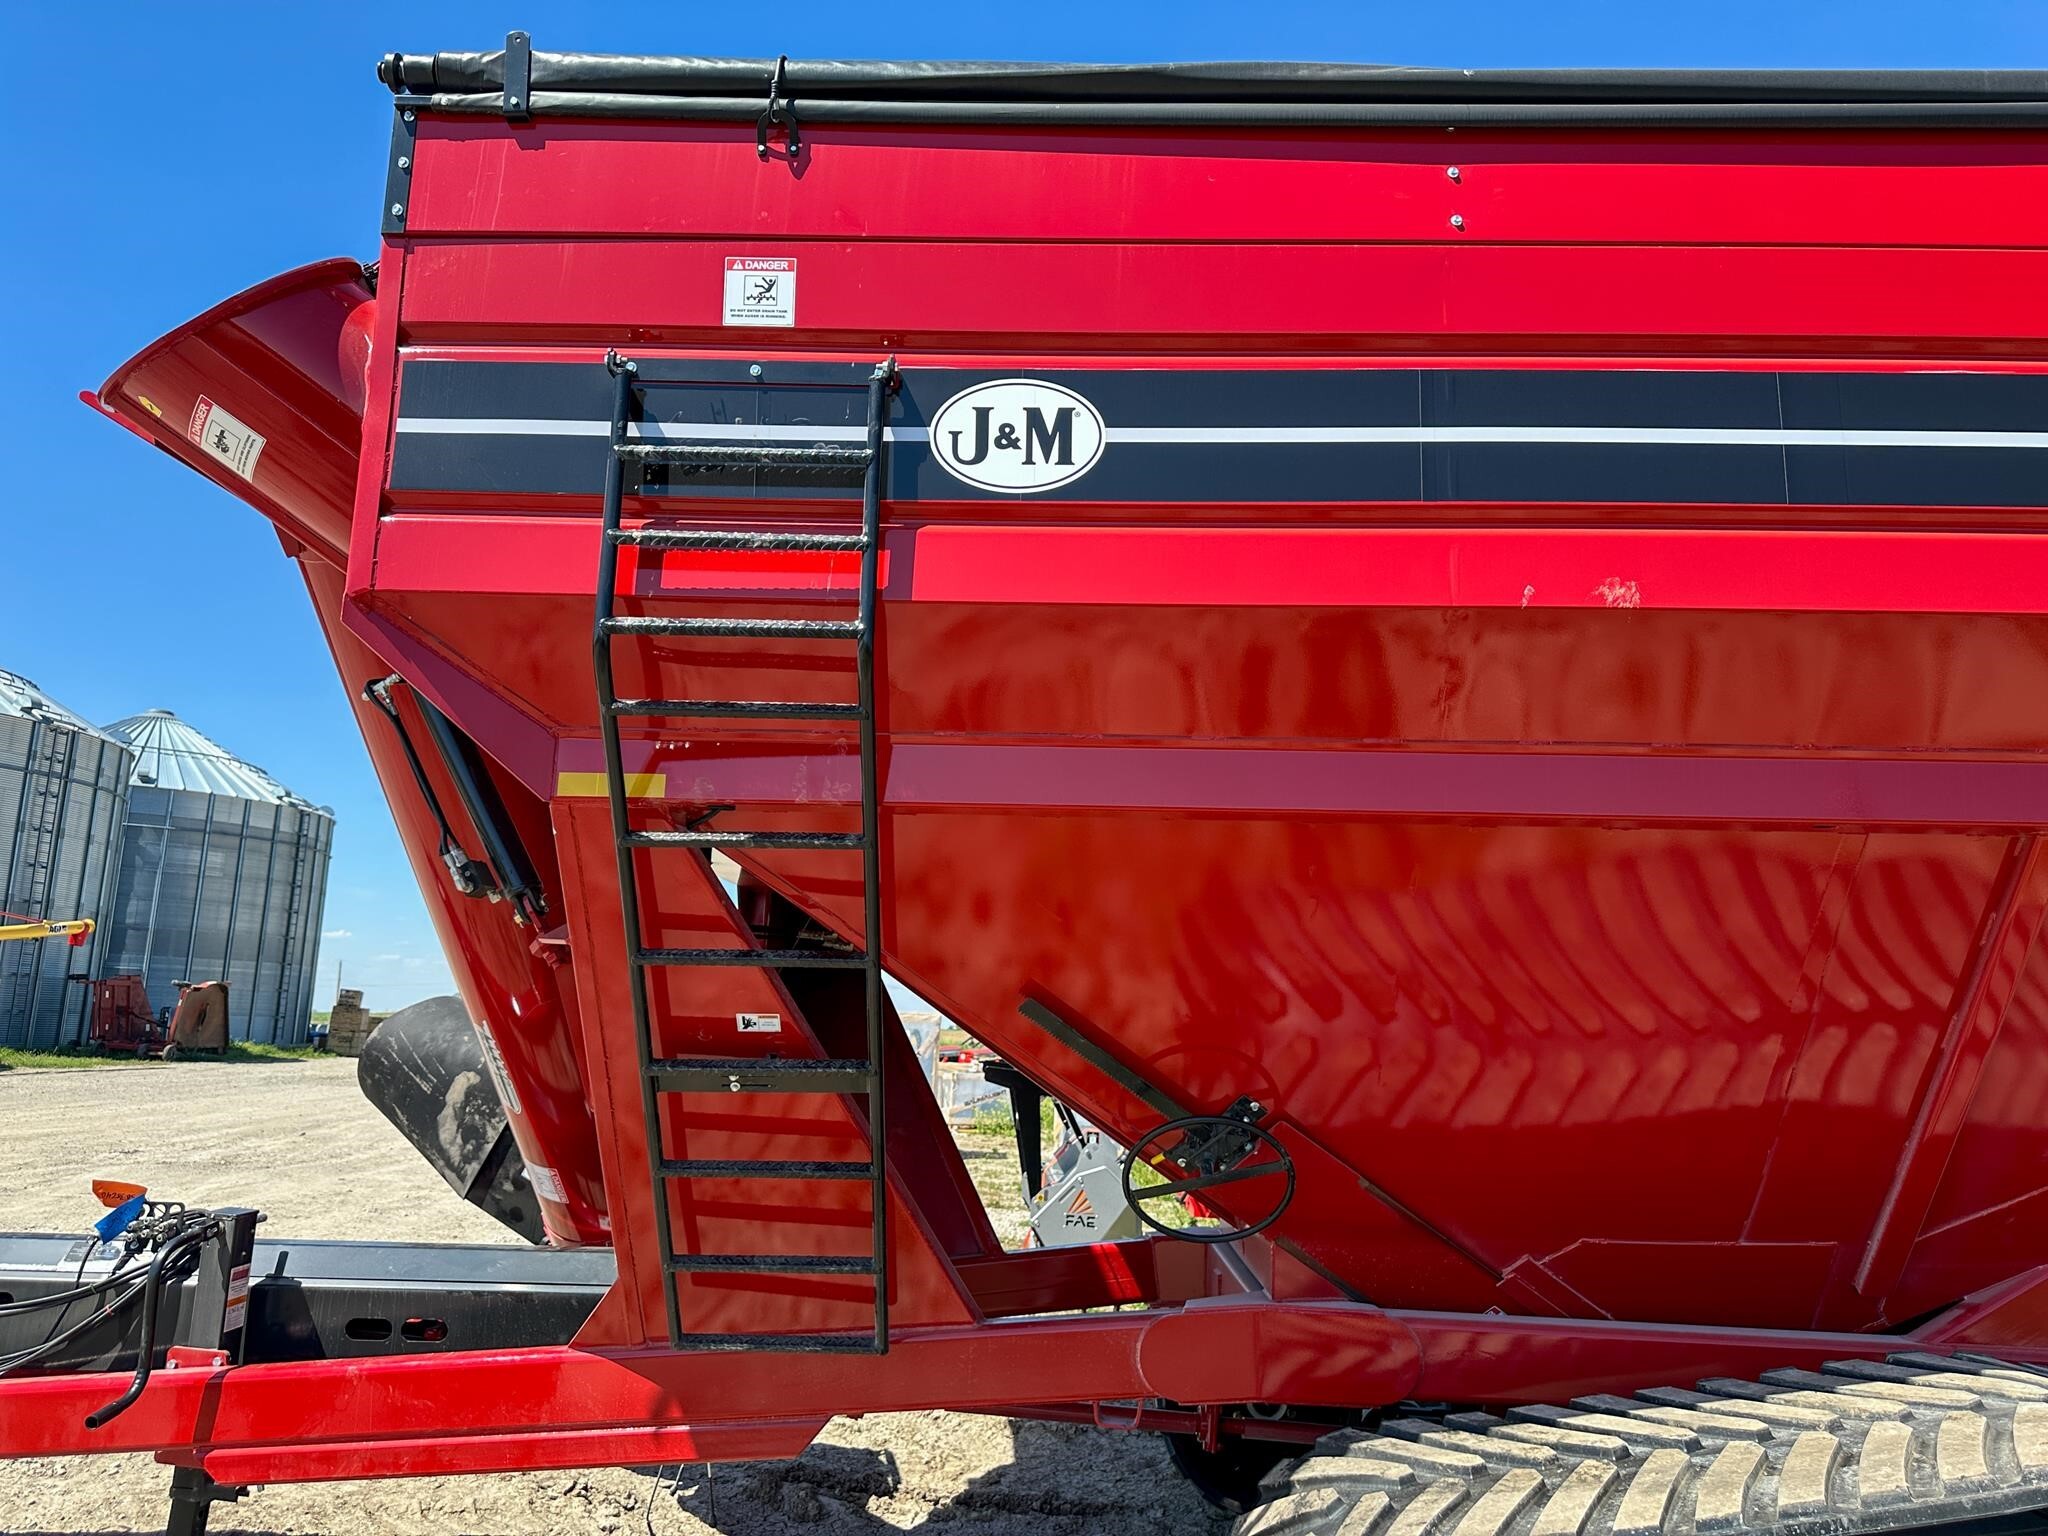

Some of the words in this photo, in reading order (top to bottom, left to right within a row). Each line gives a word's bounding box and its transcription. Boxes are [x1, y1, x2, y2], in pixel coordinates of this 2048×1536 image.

[745, 260, 788, 270] DANGER
[191, 403, 209, 436] DANGER
[948, 406, 1076, 466] J&M
[1065, 1214, 1096, 1228] FAE
